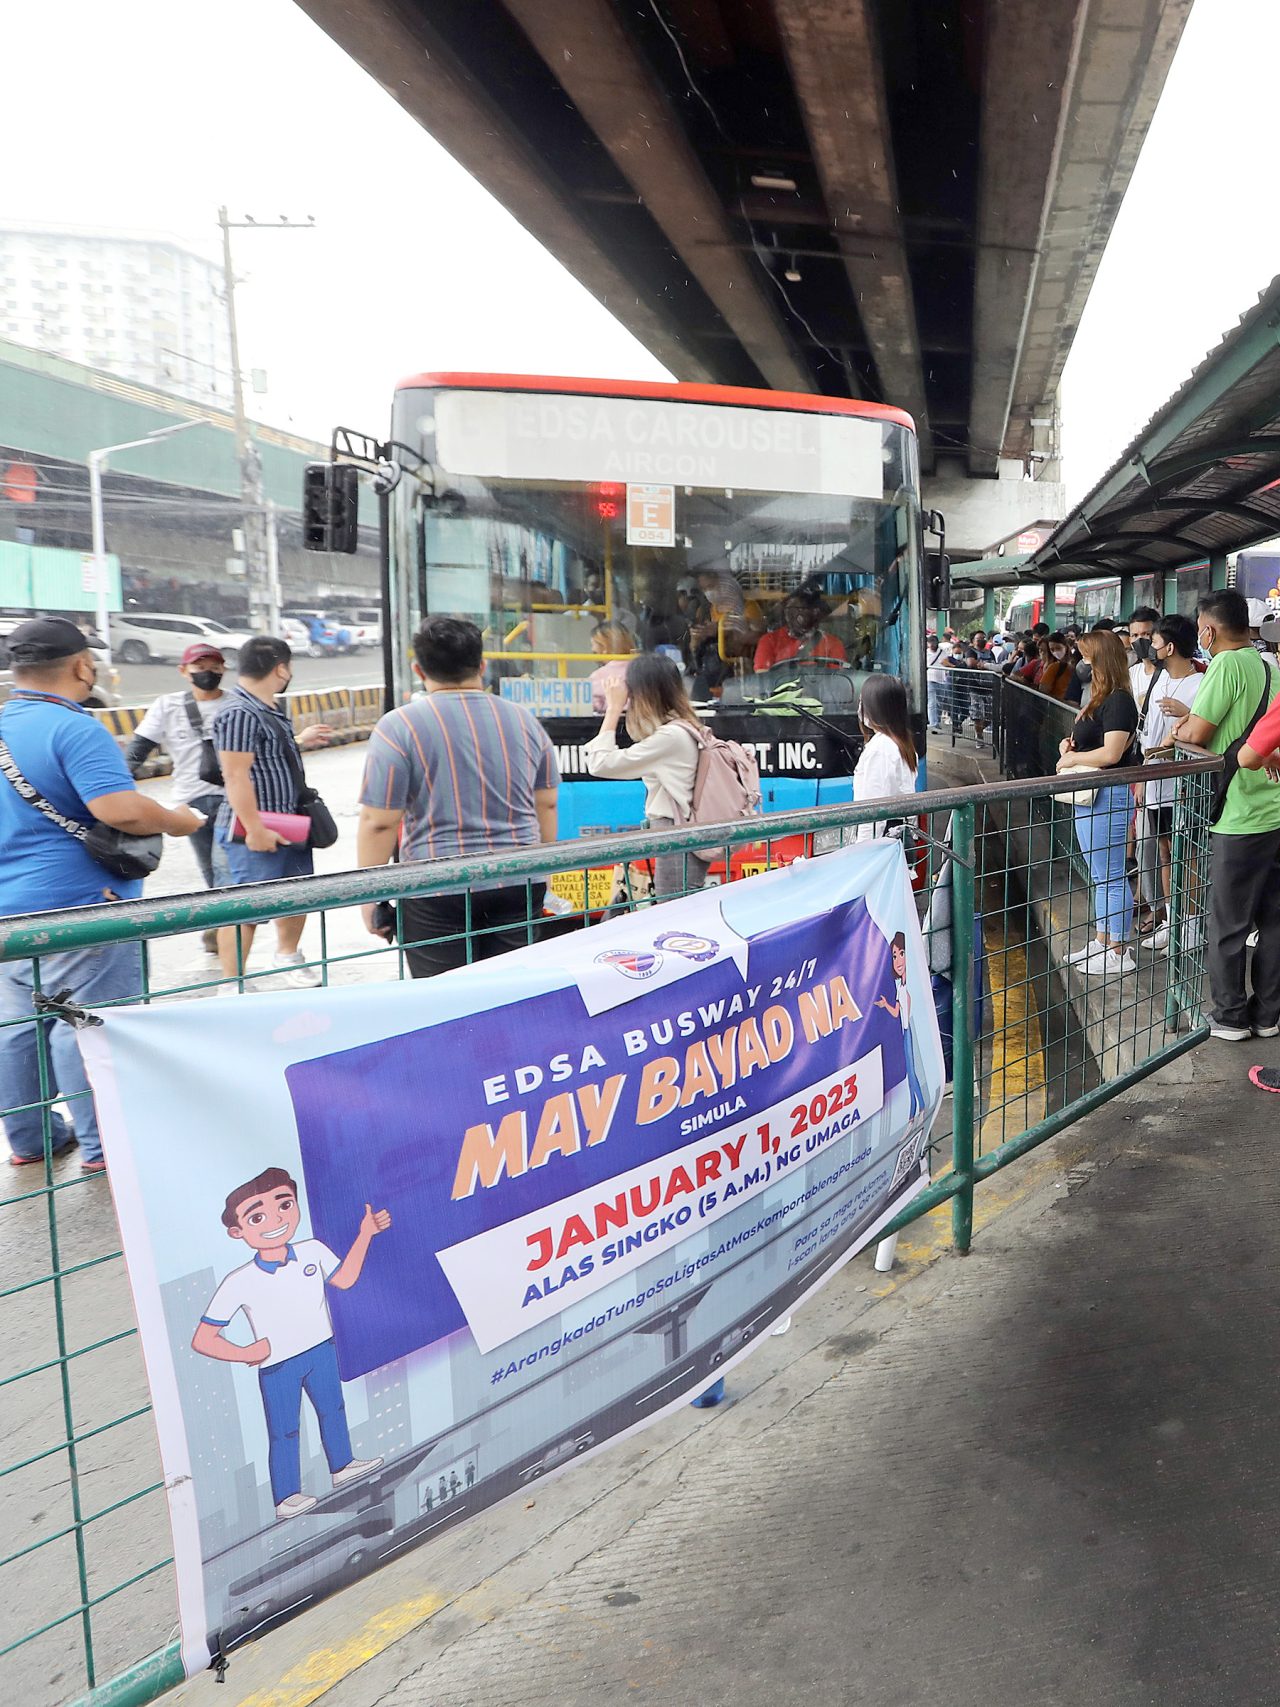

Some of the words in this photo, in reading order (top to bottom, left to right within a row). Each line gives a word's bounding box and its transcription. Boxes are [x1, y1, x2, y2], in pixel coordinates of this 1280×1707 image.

[517, 403, 616, 442] EDSA
[625, 407, 817, 455] CAROUSEL
[603, 449, 717, 477] AIRCON
[639, 530, 665, 540] 054
[643, 503, 659, 527] E
[778, 742, 823, 770] INC.
[482, 1044, 607, 1106] EDSA
[623, 985, 761, 1057] BUSWAY
[770, 957, 818, 998] 24/7
[451, 1073, 627, 1201] MAY
[635, 1004, 795, 1126] BAYAD
[797, 975, 864, 1045] NA
[680, 1095, 748, 1136] SIMULA
[526, 1133, 748, 1272] JANUARY
[757, 1122, 781, 1155] 1,
[789, 1073, 859, 1138] 2023
[521, 1254, 595, 1309] ALAS
[601, 1206, 692, 1266] SINGKO
[698, 1192, 717, 1218] (5
[722, 1161, 771, 1202] A.M.)
[776, 1145, 801, 1172] NG
[805, 1108, 861, 1153] UMAGA
[787, 1242, 817, 1271] i-scan
[819, 1223, 839, 1245] lang
[840, 1208, 857, 1227] ang
[858, 1194, 871, 1210] QR
[794, 1228, 818, 1251] Para
[820, 1217, 831, 1231] sa
[832, 1199, 853, 1221] mga
[491, 1146, 873, 1386] #ArangkadaTungoSaLigtasAtMasKomportablengPasada
